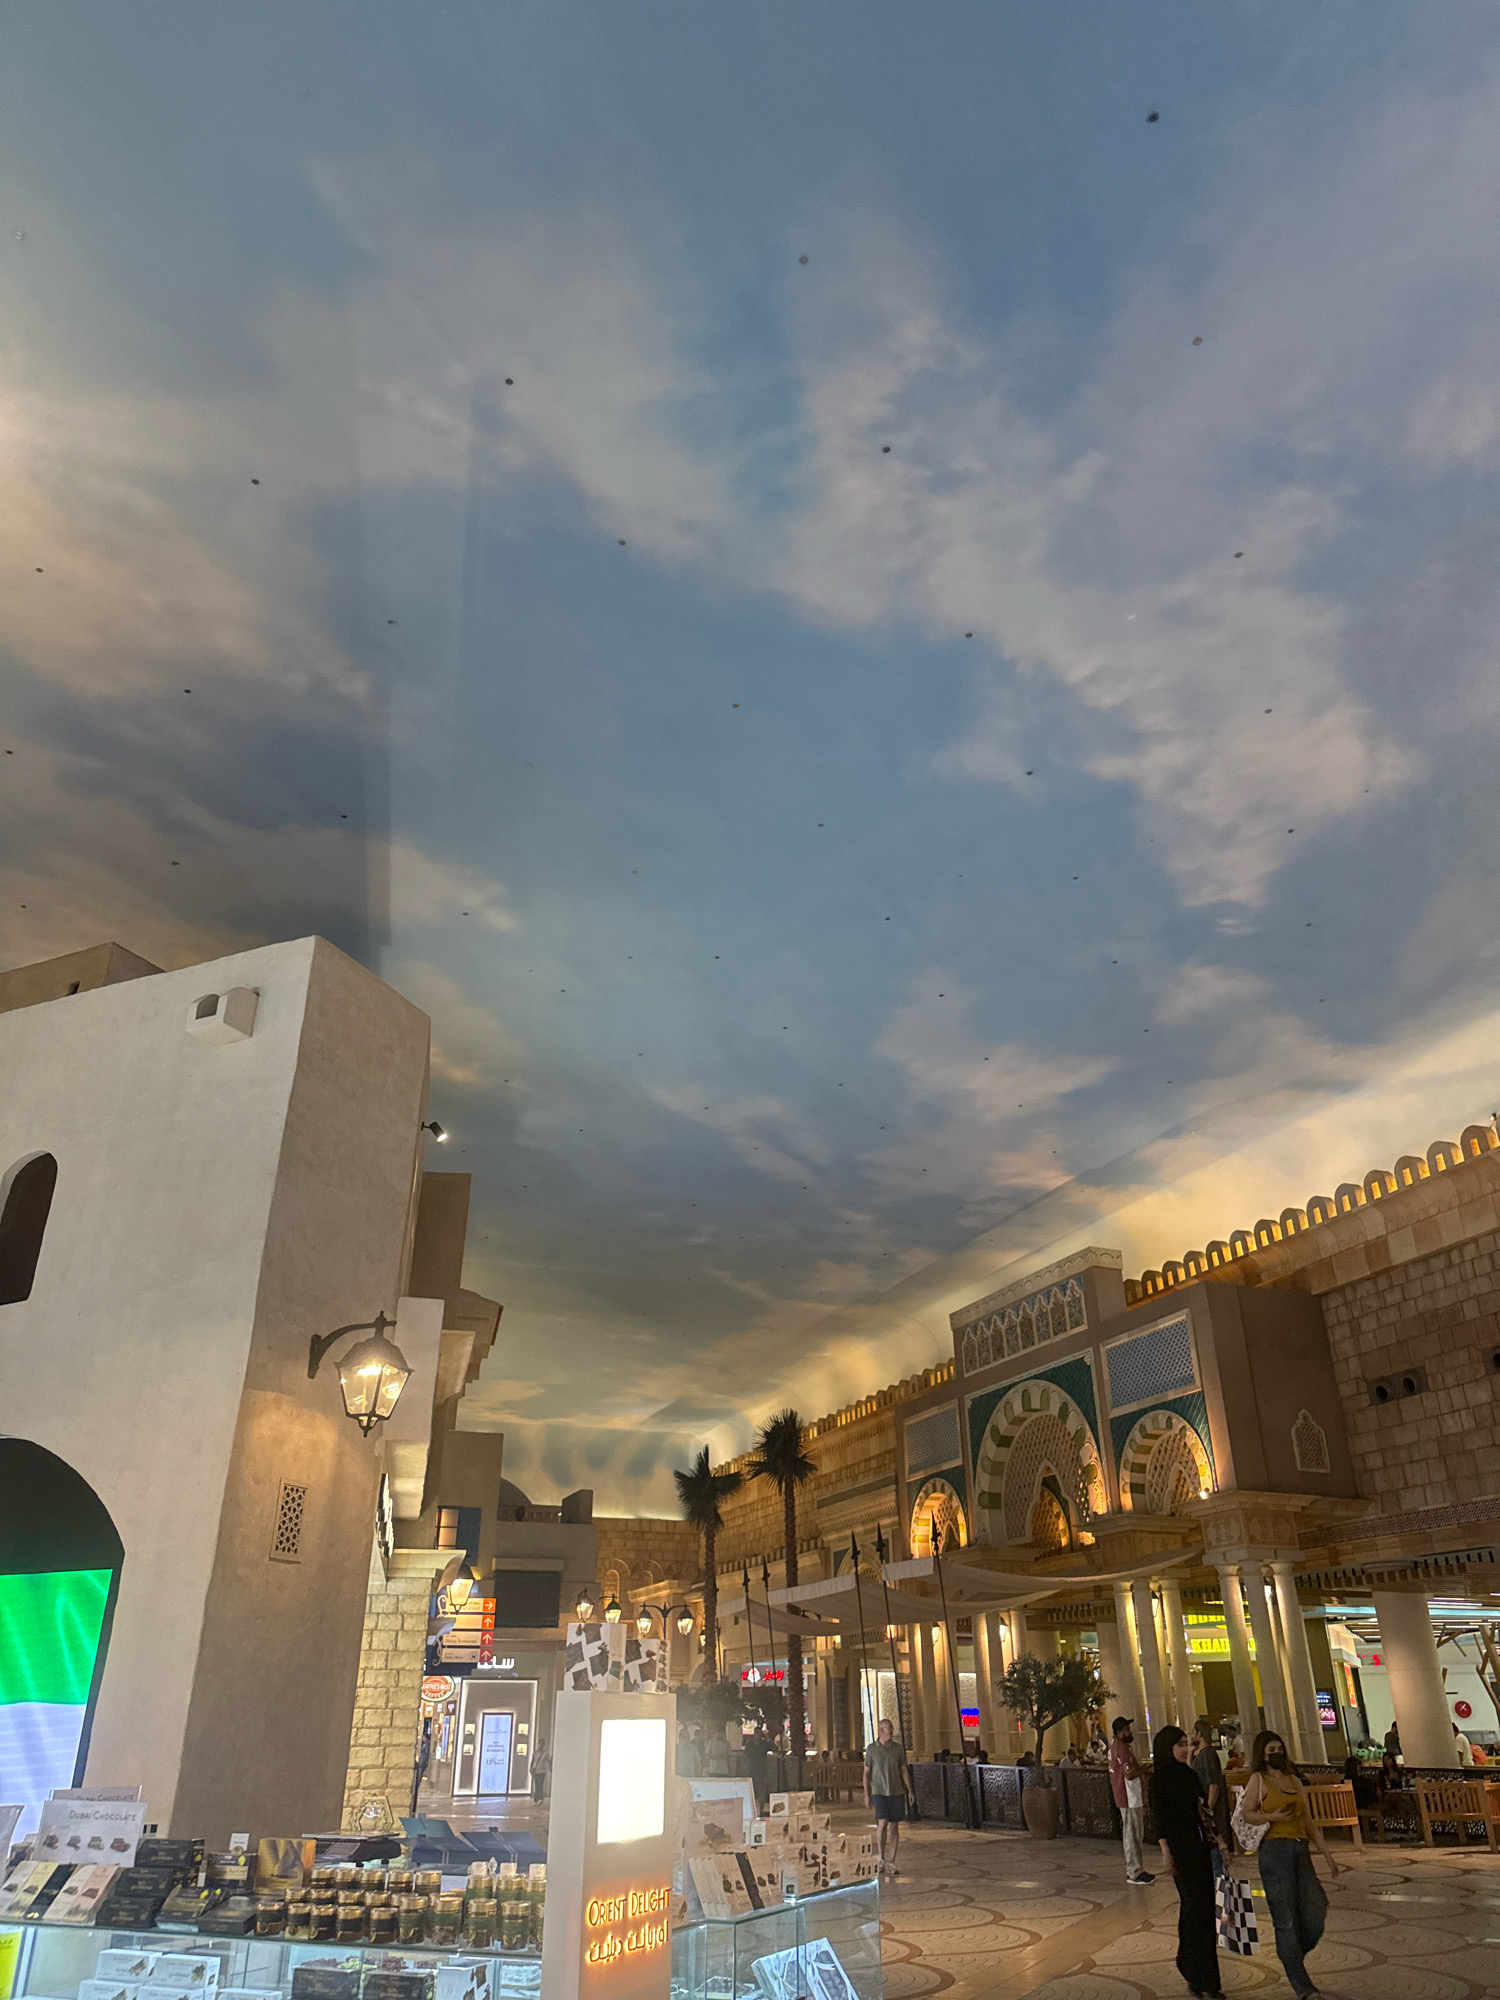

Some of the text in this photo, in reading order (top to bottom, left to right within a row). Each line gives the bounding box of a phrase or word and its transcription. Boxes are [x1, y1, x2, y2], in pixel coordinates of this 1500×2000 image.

[69, 1810, 137, 1820] DUBAI CHOCOLATE
[587, 1888, 671, 1926] ORIENT DELIGHT
